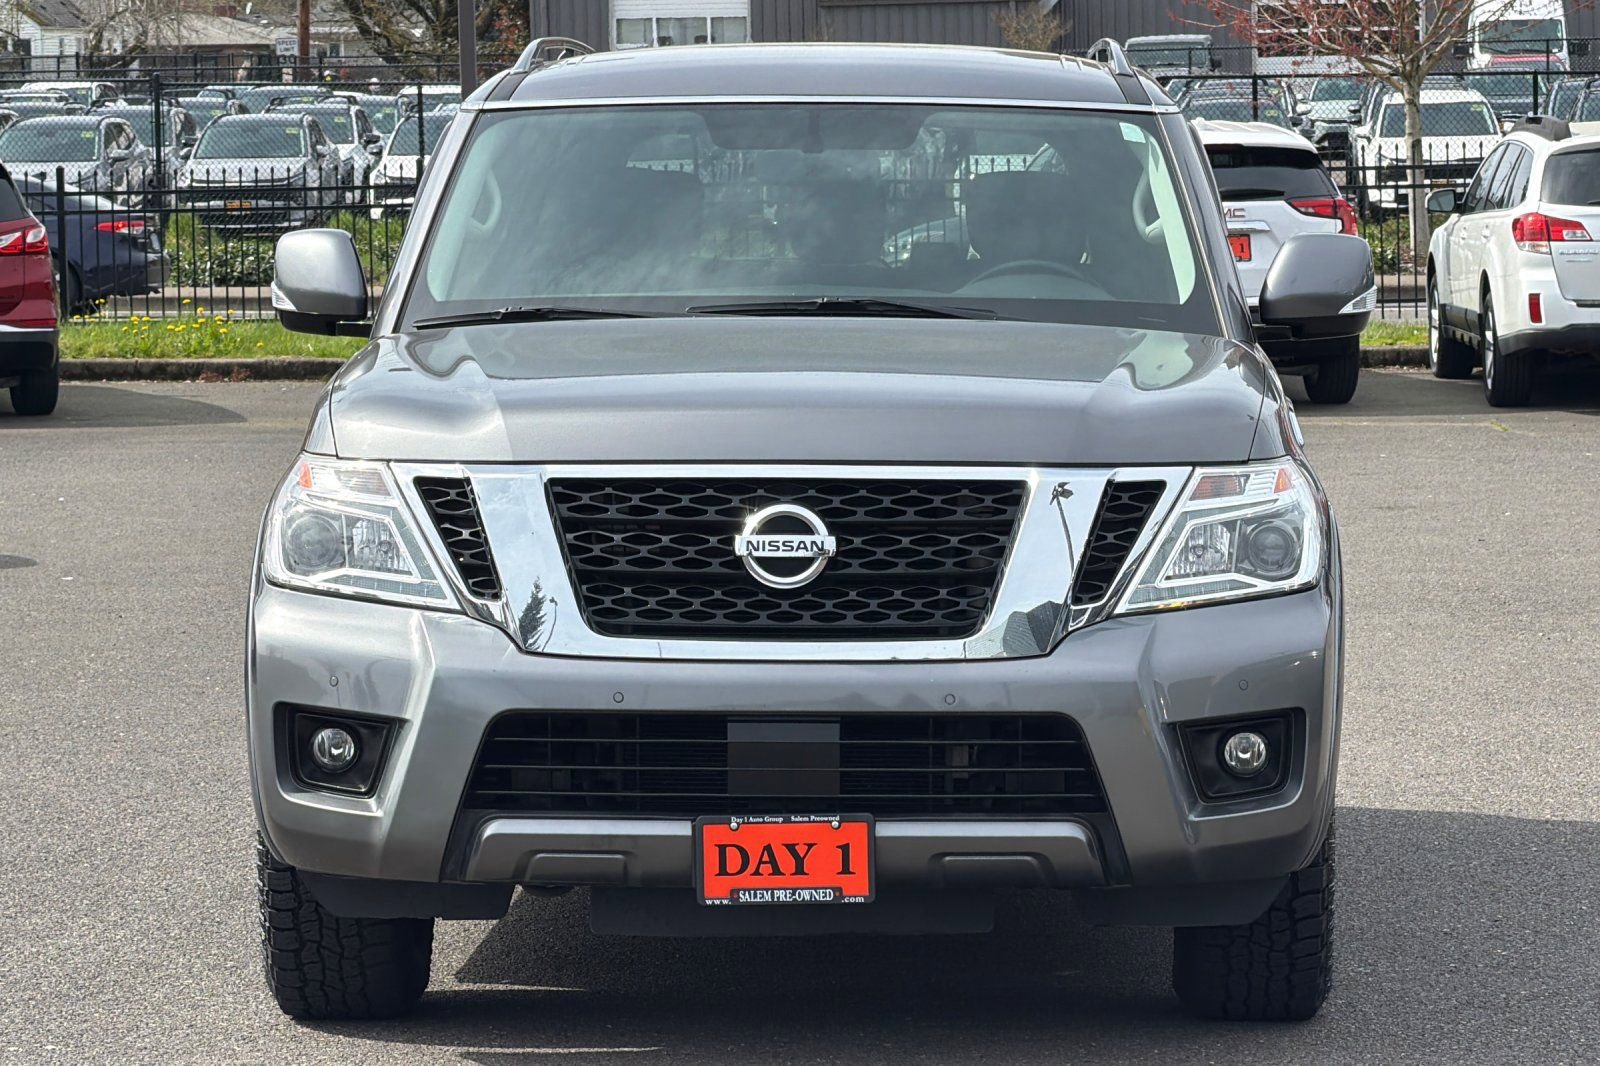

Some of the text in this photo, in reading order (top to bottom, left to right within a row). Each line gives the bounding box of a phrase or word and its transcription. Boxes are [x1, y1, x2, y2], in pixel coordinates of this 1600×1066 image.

[278, 54, 297, 64] 30
[745, 540, 825, 552] NISSAN
[731, 816, 744, 824] Day
[764, 815, 784, 824] Group
[714, 842, 856, 876] DAY 1
[739, 890, 771, 902] SALEM
[773, 889, 834, 902] PRE-OWNED
